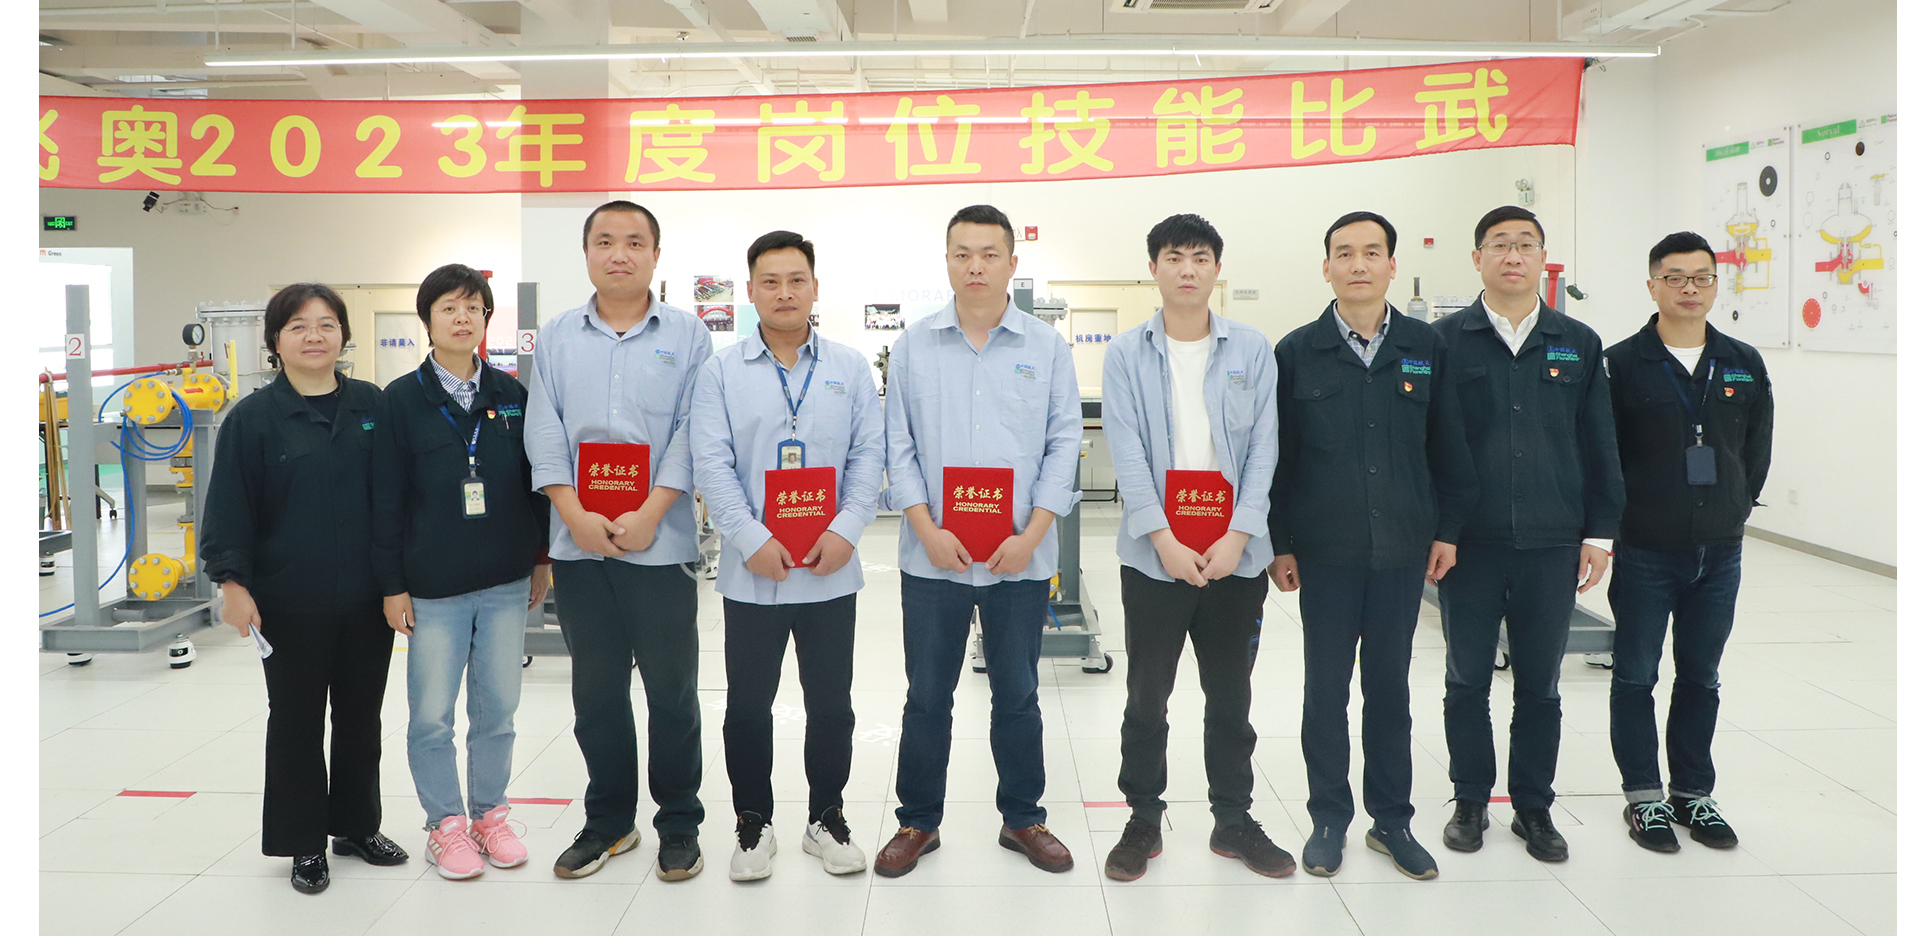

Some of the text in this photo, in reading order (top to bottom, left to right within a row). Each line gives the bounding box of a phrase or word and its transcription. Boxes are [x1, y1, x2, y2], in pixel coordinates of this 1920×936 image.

[39, 67, 1508, 187] 奥2023年度岗位技能比武
[380, 338, 415, 347] 非请莫入
[521, 332, 535, 352] 3
[1075, 334, 1112, 343] 机房重地
[68, 337, 82, 357] 2
[588, 462, 639, 478] 荣誉证书
[588, 484, 638, 492] CREDENTIAL
[953, 485, 1004, 501] 荣誉证书
[776, 488, 826, 505] 荣誉证书
[1176, 488, 1227, 504] 荣誉证书
[779, 505, 823, 513] HONORARY
[953, 506, 1002, 514] CREDENTIAL
[955, 501, 999, 509] HONORARY
[776, 510, 826, 519] CREDENTIAL
